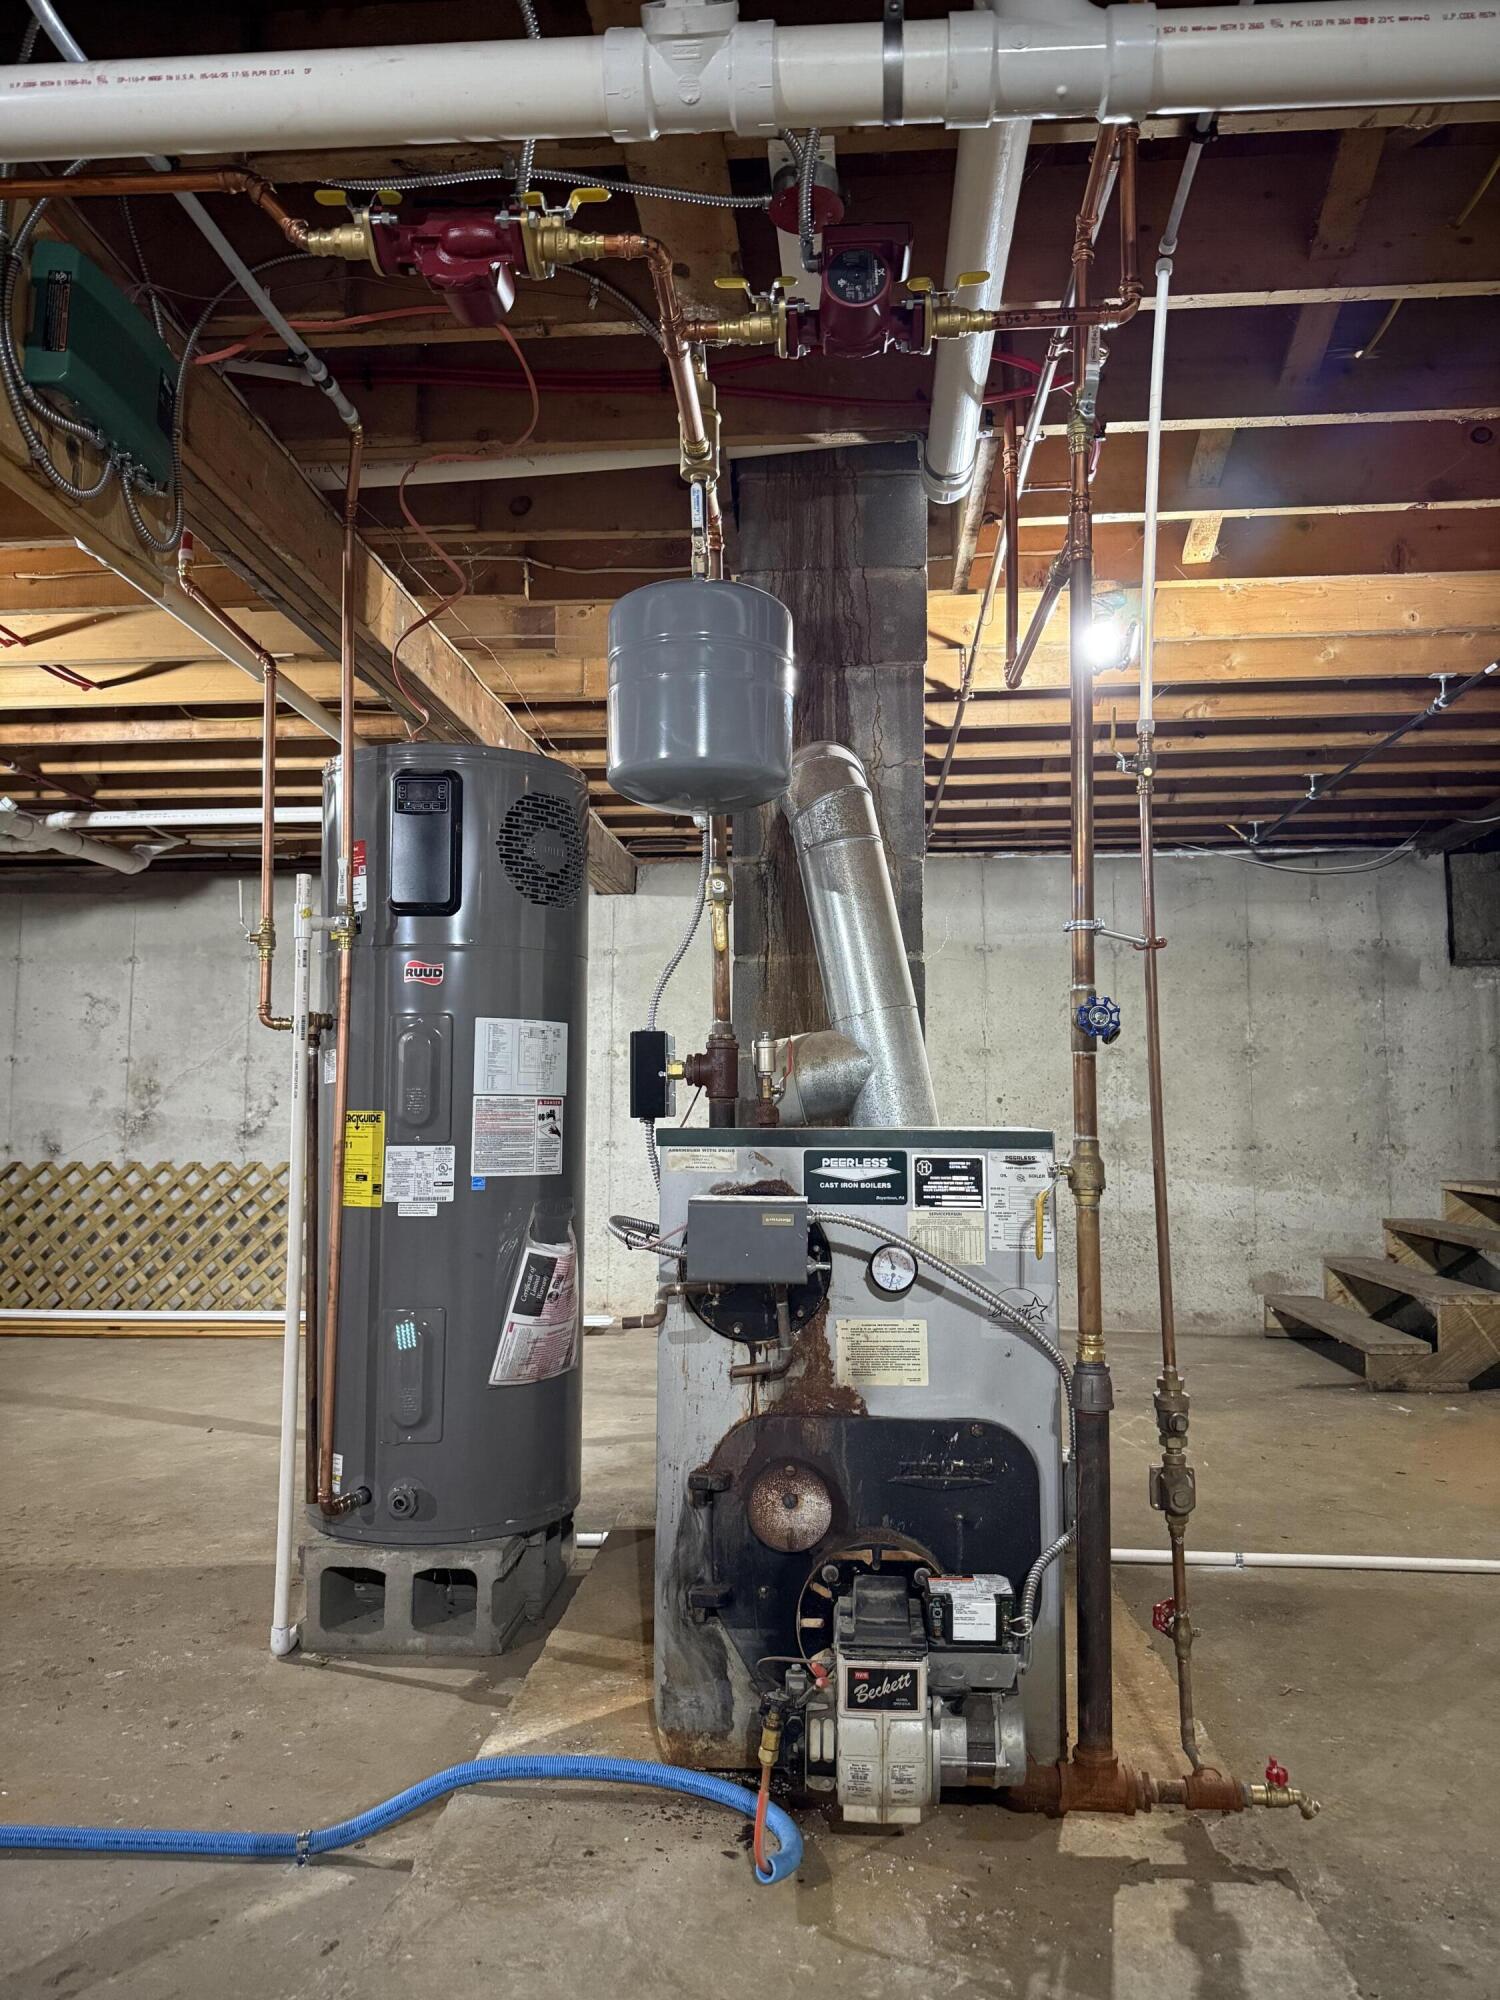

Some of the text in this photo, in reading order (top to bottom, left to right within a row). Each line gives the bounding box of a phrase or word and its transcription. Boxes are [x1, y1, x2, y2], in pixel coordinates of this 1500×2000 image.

[1290, 20, 1303, 28] PVC
[1307, 19, 1323, 27] 1120
[1163, 26, 1176, 34] SCH
[405, 967, 443, 978] RUUD
[821, 1157, 889, 1168] PEERLESS
[520, 1272, 535, 1303] Certificate
[853, 1672, 912, 1704] Beckett
